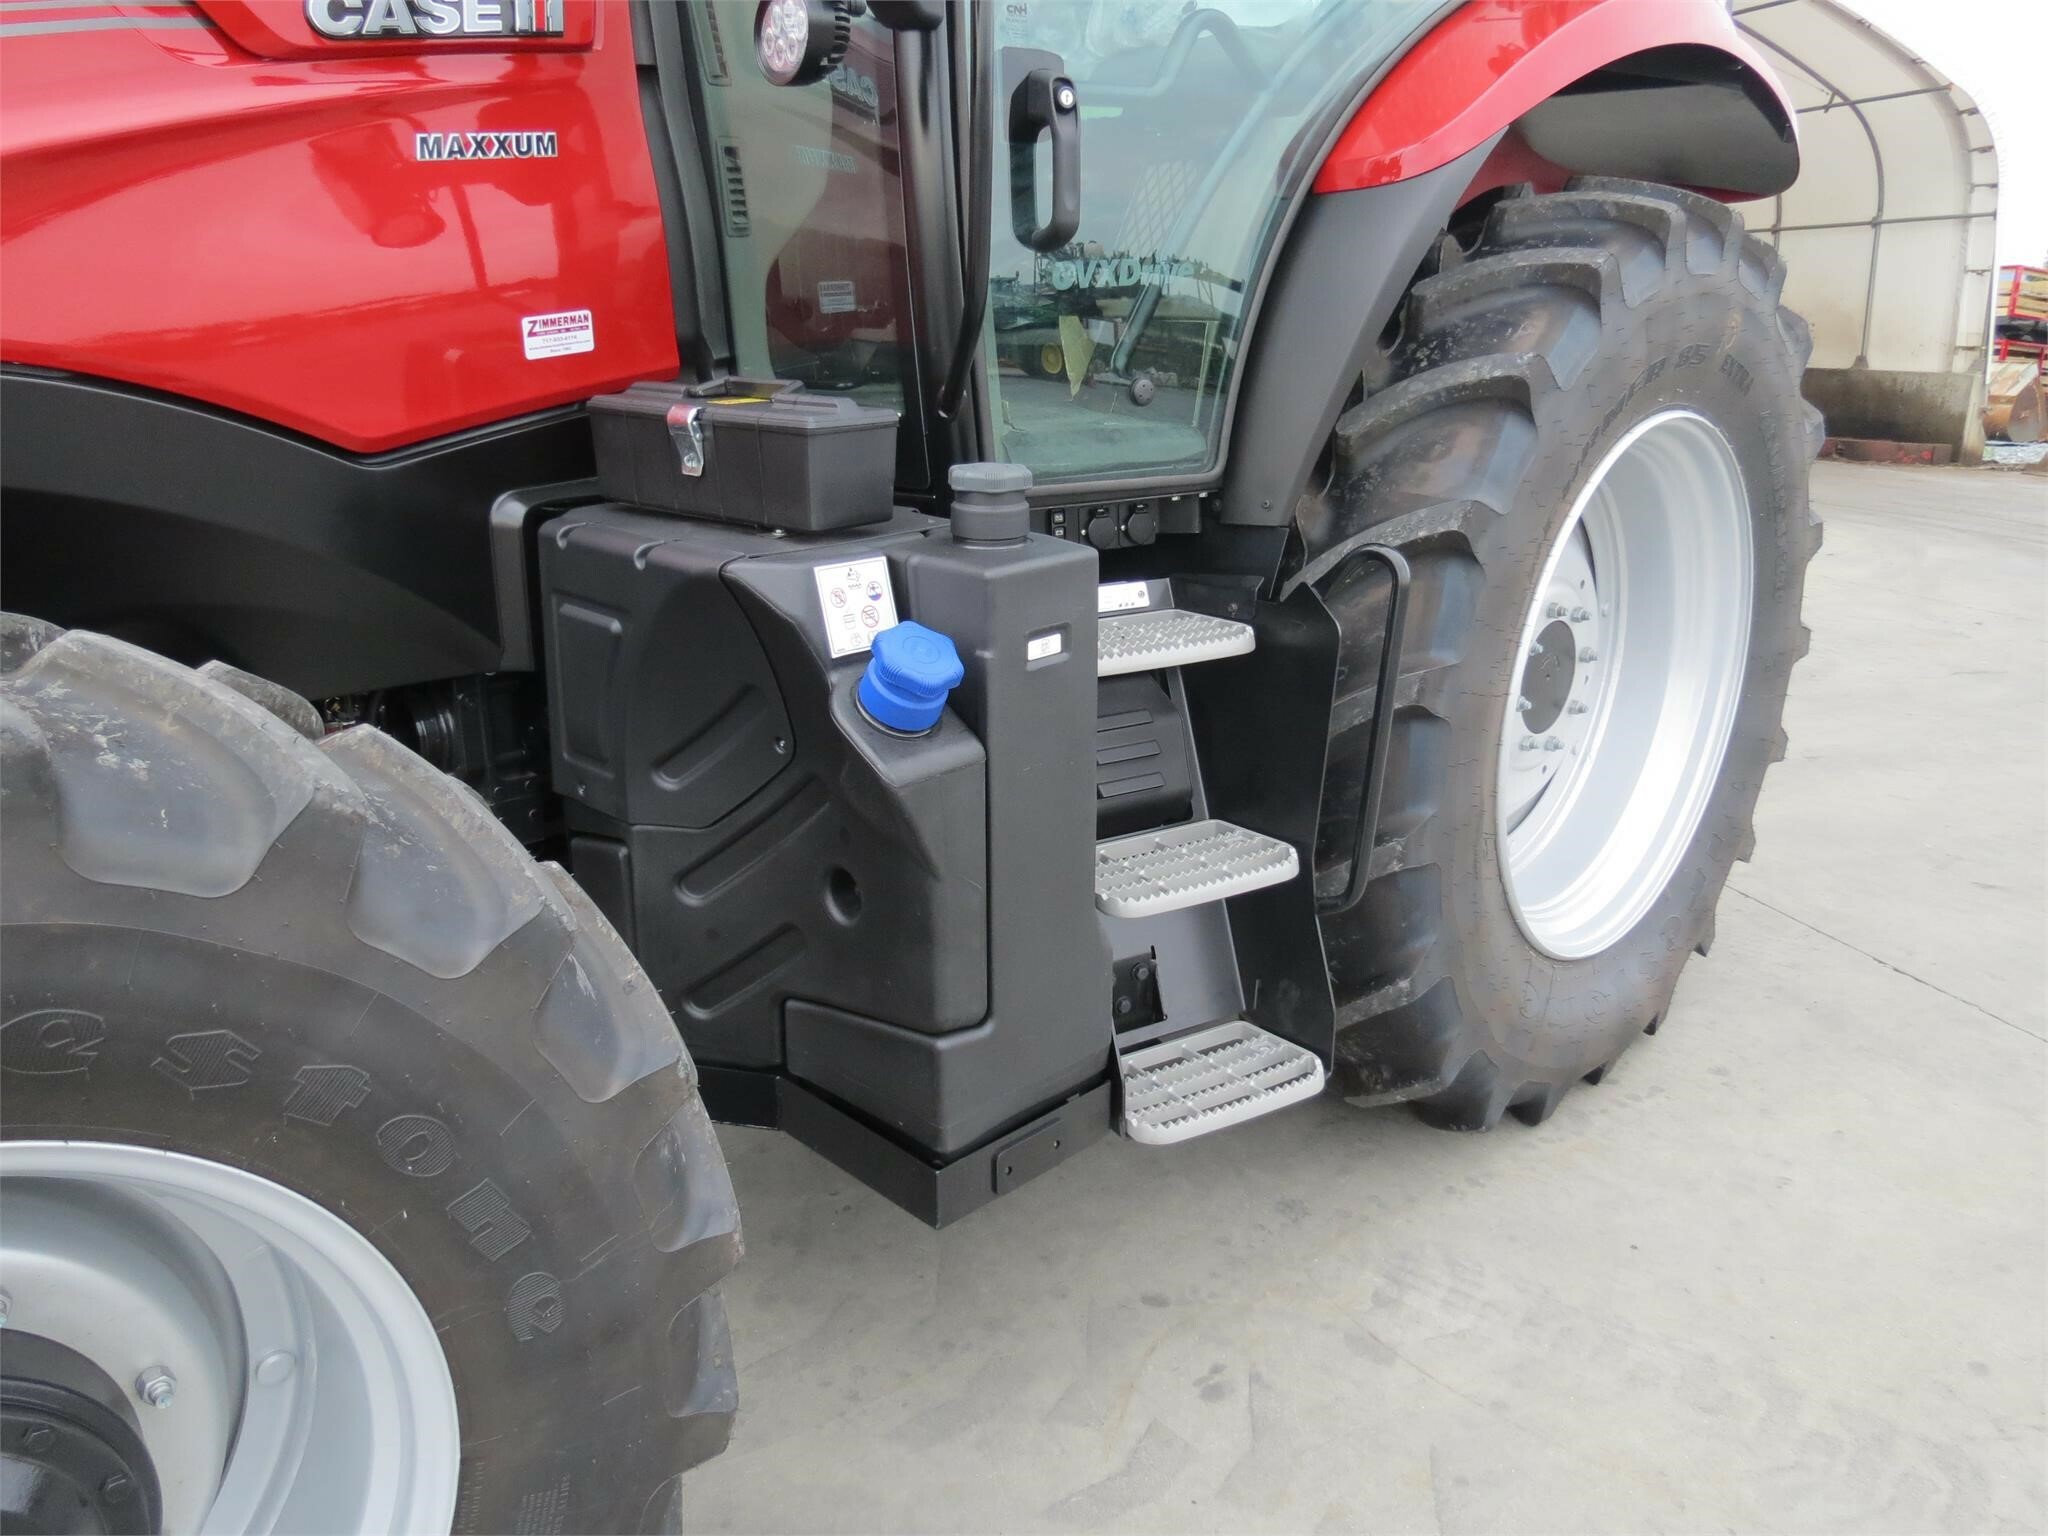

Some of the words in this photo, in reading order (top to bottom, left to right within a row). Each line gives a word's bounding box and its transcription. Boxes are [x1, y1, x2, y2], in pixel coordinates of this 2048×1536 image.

[307, 0, 503, 36] CASE
[1006, 3, 1028, 16] CNH
[416, 132, 558, 161] MAXXUM
[527, 313, 589, 337] ZIMMERMAN
[1719, 353, 1755, 396] EXTRA
